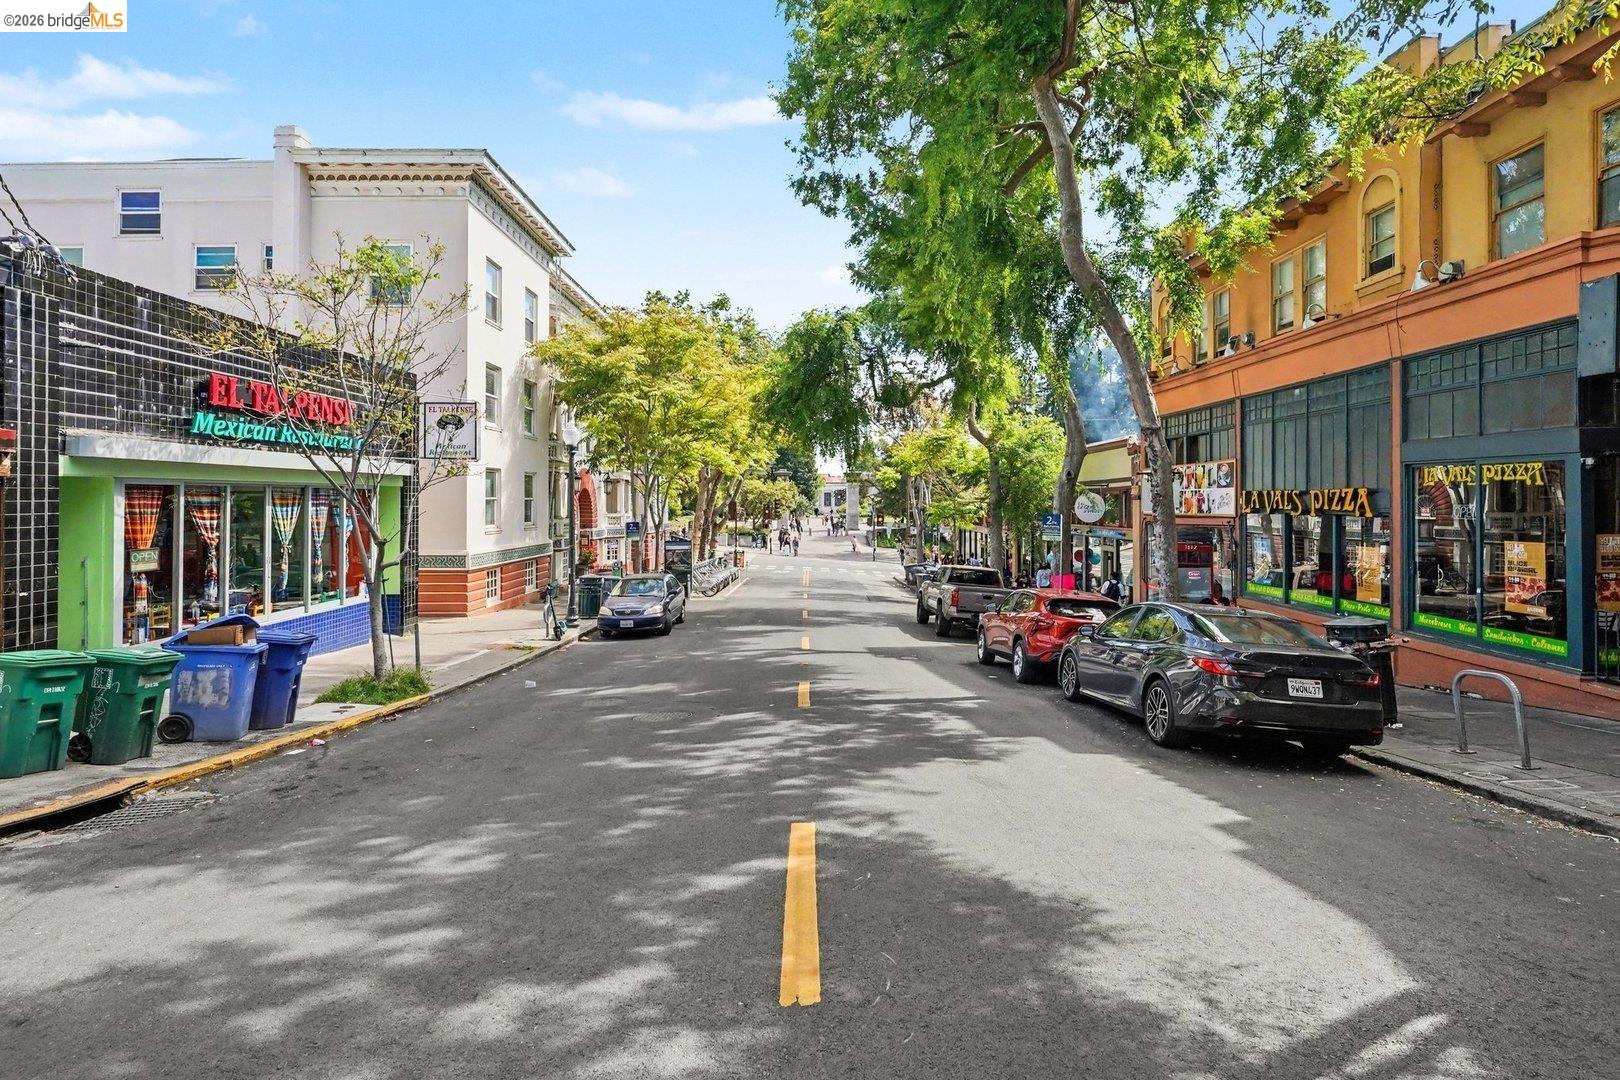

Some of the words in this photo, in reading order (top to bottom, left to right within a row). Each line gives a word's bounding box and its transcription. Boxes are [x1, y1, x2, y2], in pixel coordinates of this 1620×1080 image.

[209, 373, 244, 408] EL
[191, 411, 276, 442] Mexican
[1482, 462, 1544, 486] PIZZA
[1242, 490, 1260, 514] LA
[1309, 487, 1374, 518] PIZZA
[1046, 516, 1052, 525] 2
[131, 551, 159, 562] OPEN
